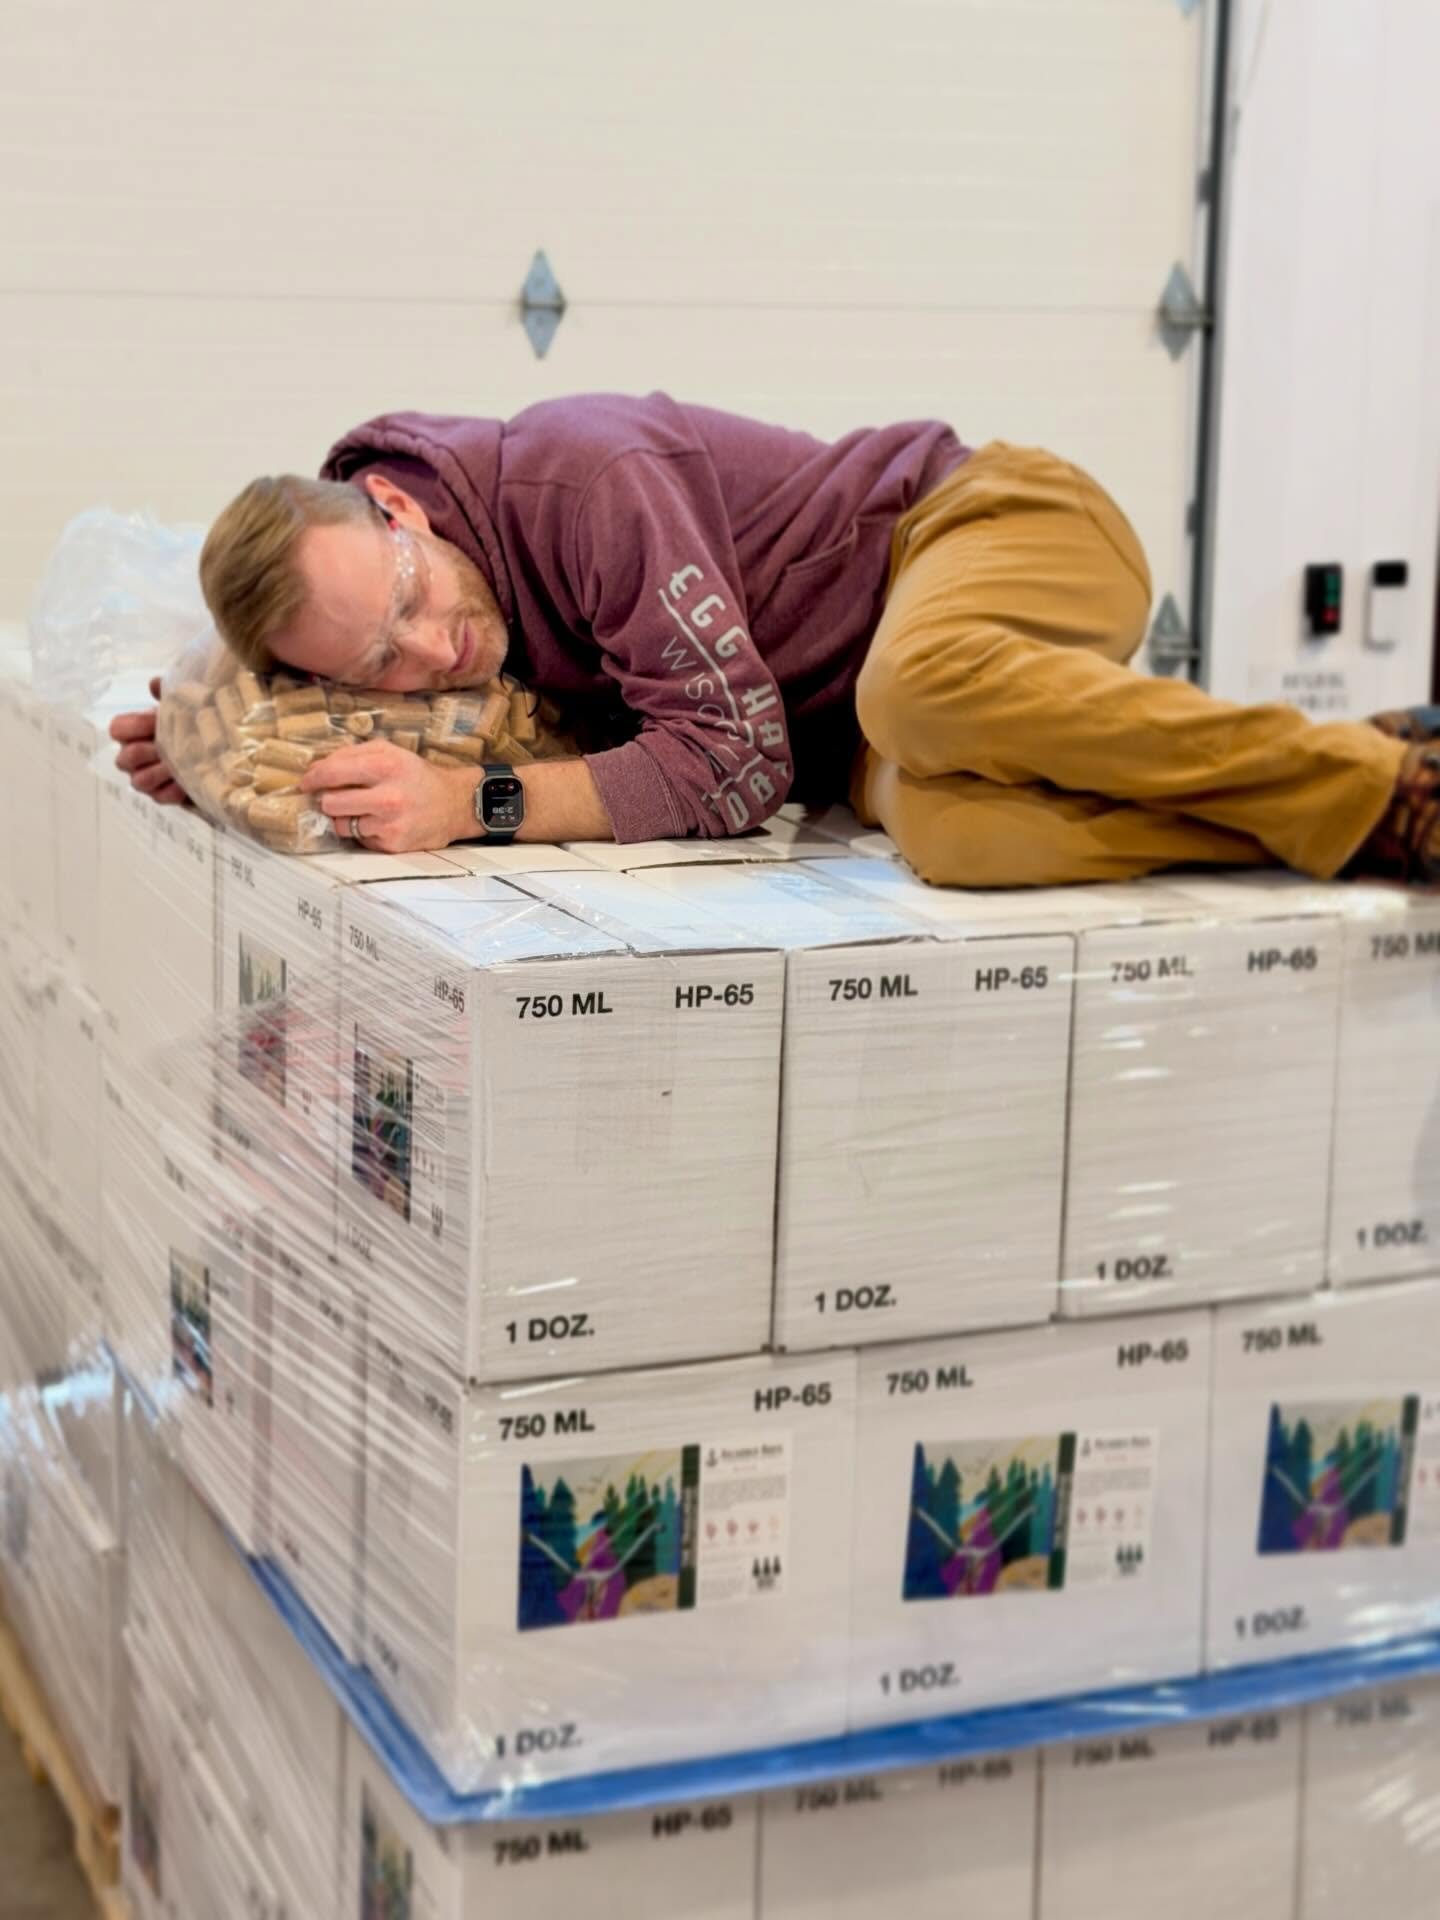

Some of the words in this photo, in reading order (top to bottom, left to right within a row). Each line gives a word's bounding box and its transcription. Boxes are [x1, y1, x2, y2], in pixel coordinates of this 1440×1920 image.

[669, 564, 748, 659] EGG
[1246, 946, 1319, 973] HP-65
[1370, 933, 1411, 960] 750
[974, 965, 1049, 992] HP-65
[1110, 958, 1153, 984] 750
[1156, 955, 1194, 979] ML
[675, 983, 754, 1009] HP-65
[828, 977, 873, 1002] 750
[879, 974, 919, 999] ML
[516, 994, 563, 1019] 750
[571, 991, 613, 1016] ML
[1354, 1227, 1368, 1248] 1
[1372, 1218, 1429, 1248] DOZ.
[1095, 1260, 1108, 1281] 1
[1113, 1254, 1175, 1282] DOZ.
[815, 1292, 826, 1313] 1
[835, 1284, 897, 1312] DOZ.
[505, 1321, 517, 1344] 1
[527, 1313, 595, 1342] DOZ.
[1241, 1326, 1284, 1354] 750
[1286, 1322, 1325, 1347] ML
[1116, 1338, 1190, 1369] HP-65
[885, 1368, 931, 1396] 750
[934, 1364, 974, 1390] ML
[753, 1381, 833, 1413] HP-65
[497, 1412, 548, 1442] 750
[552, 1408, 596, 1435] ML
[1233, 1616, 1248, 1639] 1
[1251, 1605, 1311, 1638] DOZ.
[878, 1672, 892, 1695] 1
[897, 1661, 961, 1694] DOZ.
[494, 1734, 507, 1760] 1
[513, 1721, 584, 1758] DOZ.
[650, 1802, 734, 1840] HP-65
[492, 1833, 543, 1864] 750
[545, 1828, 590, 1855] ML
